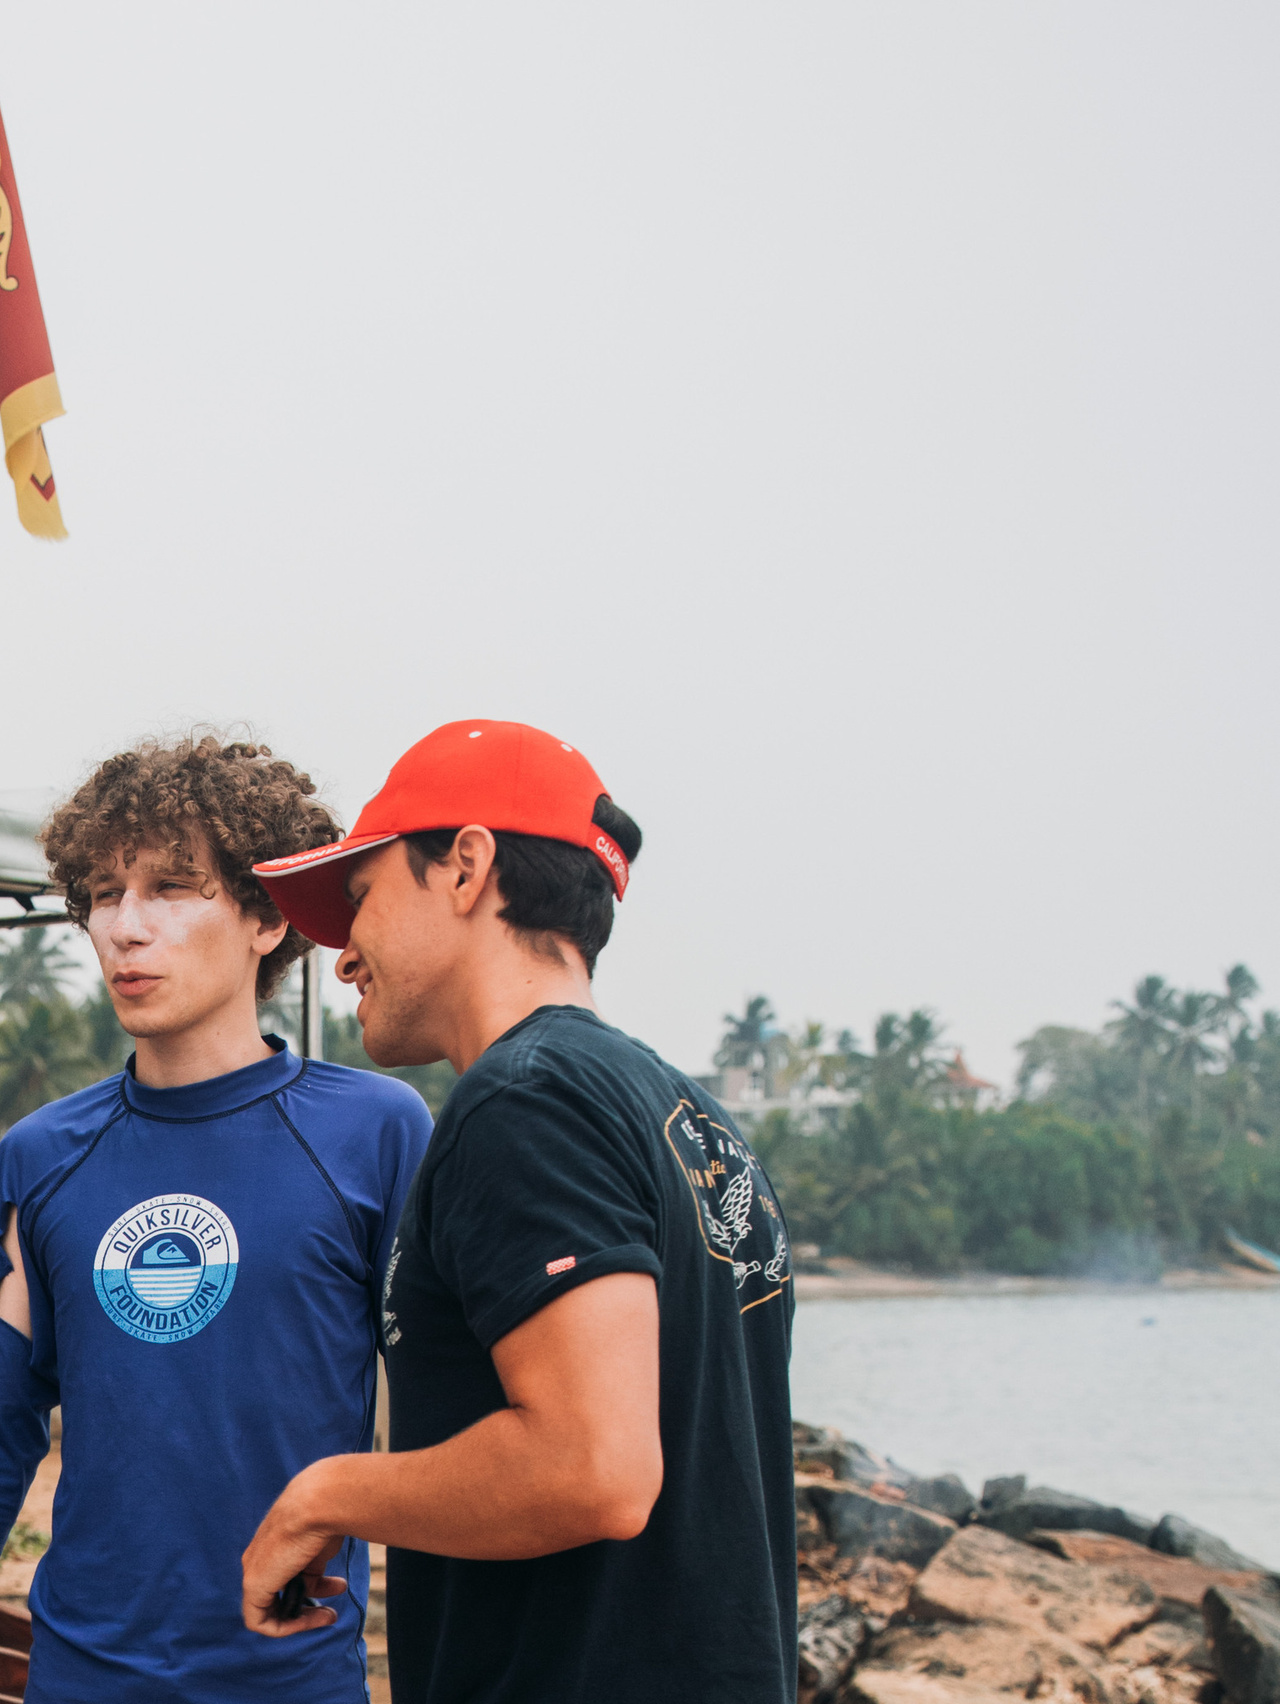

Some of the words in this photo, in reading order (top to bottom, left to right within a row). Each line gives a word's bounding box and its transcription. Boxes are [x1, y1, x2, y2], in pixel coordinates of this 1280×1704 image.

[262, 844, 343, 867] FORNIA
[595, 836, 628, 890] CALIFOR
[107, 1215, 127, 1238] SURF
[135, 1197, 166, 1213] SKATE
[176, 1195, 202, 1207] SNOW
[209, 1206, 231, 1232] SHARE
[113, 1207, 223, 1255] QUIKSILVER
[109, 1280, 220, 1330] FOUNDATION
[127, 1326, 158, 1342] SKATE
[167, 1327, 194, 1342] SNOW
[199, 1297, 225, 1327] SHARE
